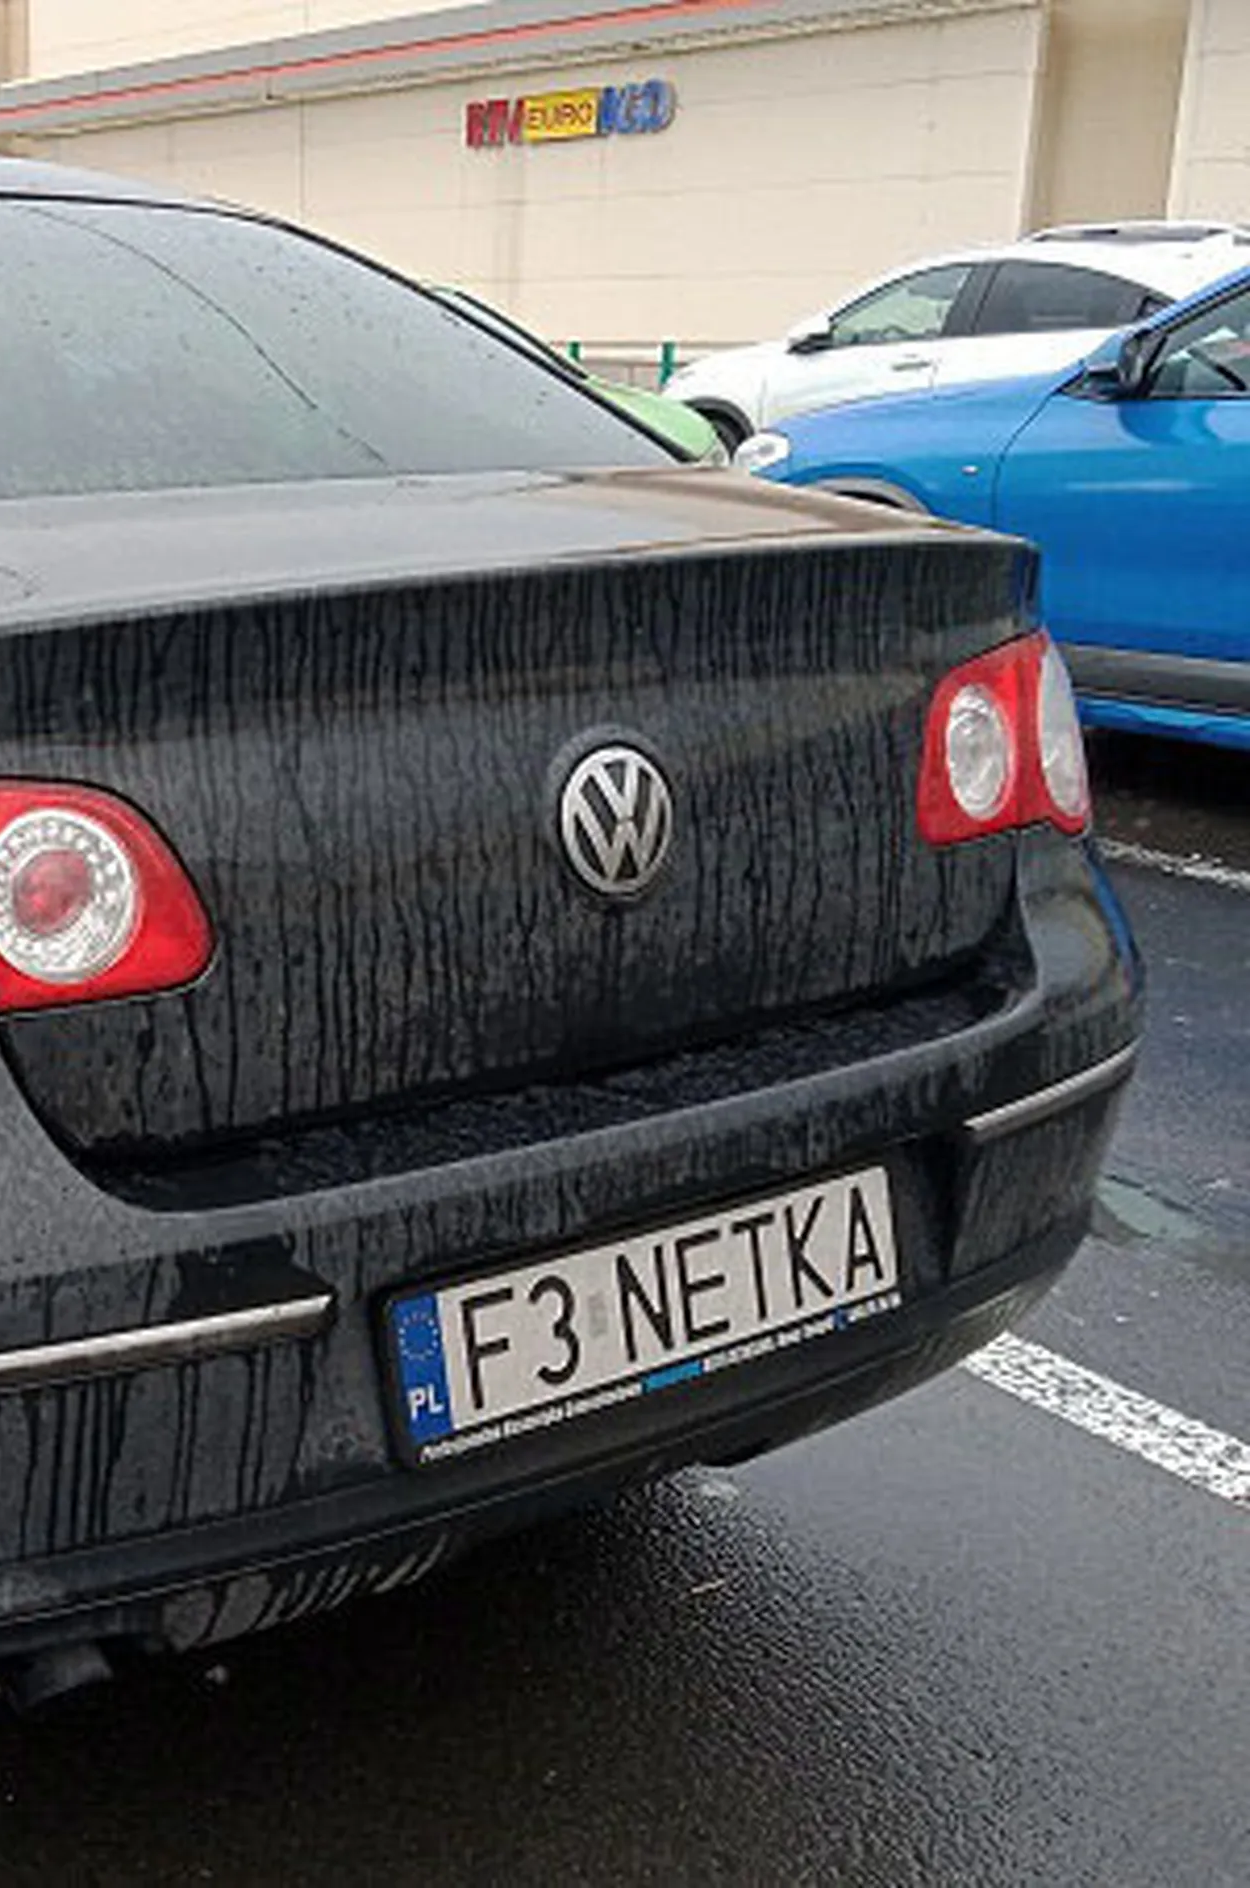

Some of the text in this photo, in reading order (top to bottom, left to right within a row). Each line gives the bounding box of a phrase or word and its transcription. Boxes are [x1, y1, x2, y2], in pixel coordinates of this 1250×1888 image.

[525, 101, 594, 130] EURO
[459, 1274, 581, 1410] F3
[615, 1185, 884, 1363] NETKA
[406, 1383, 445, 1422] PL
